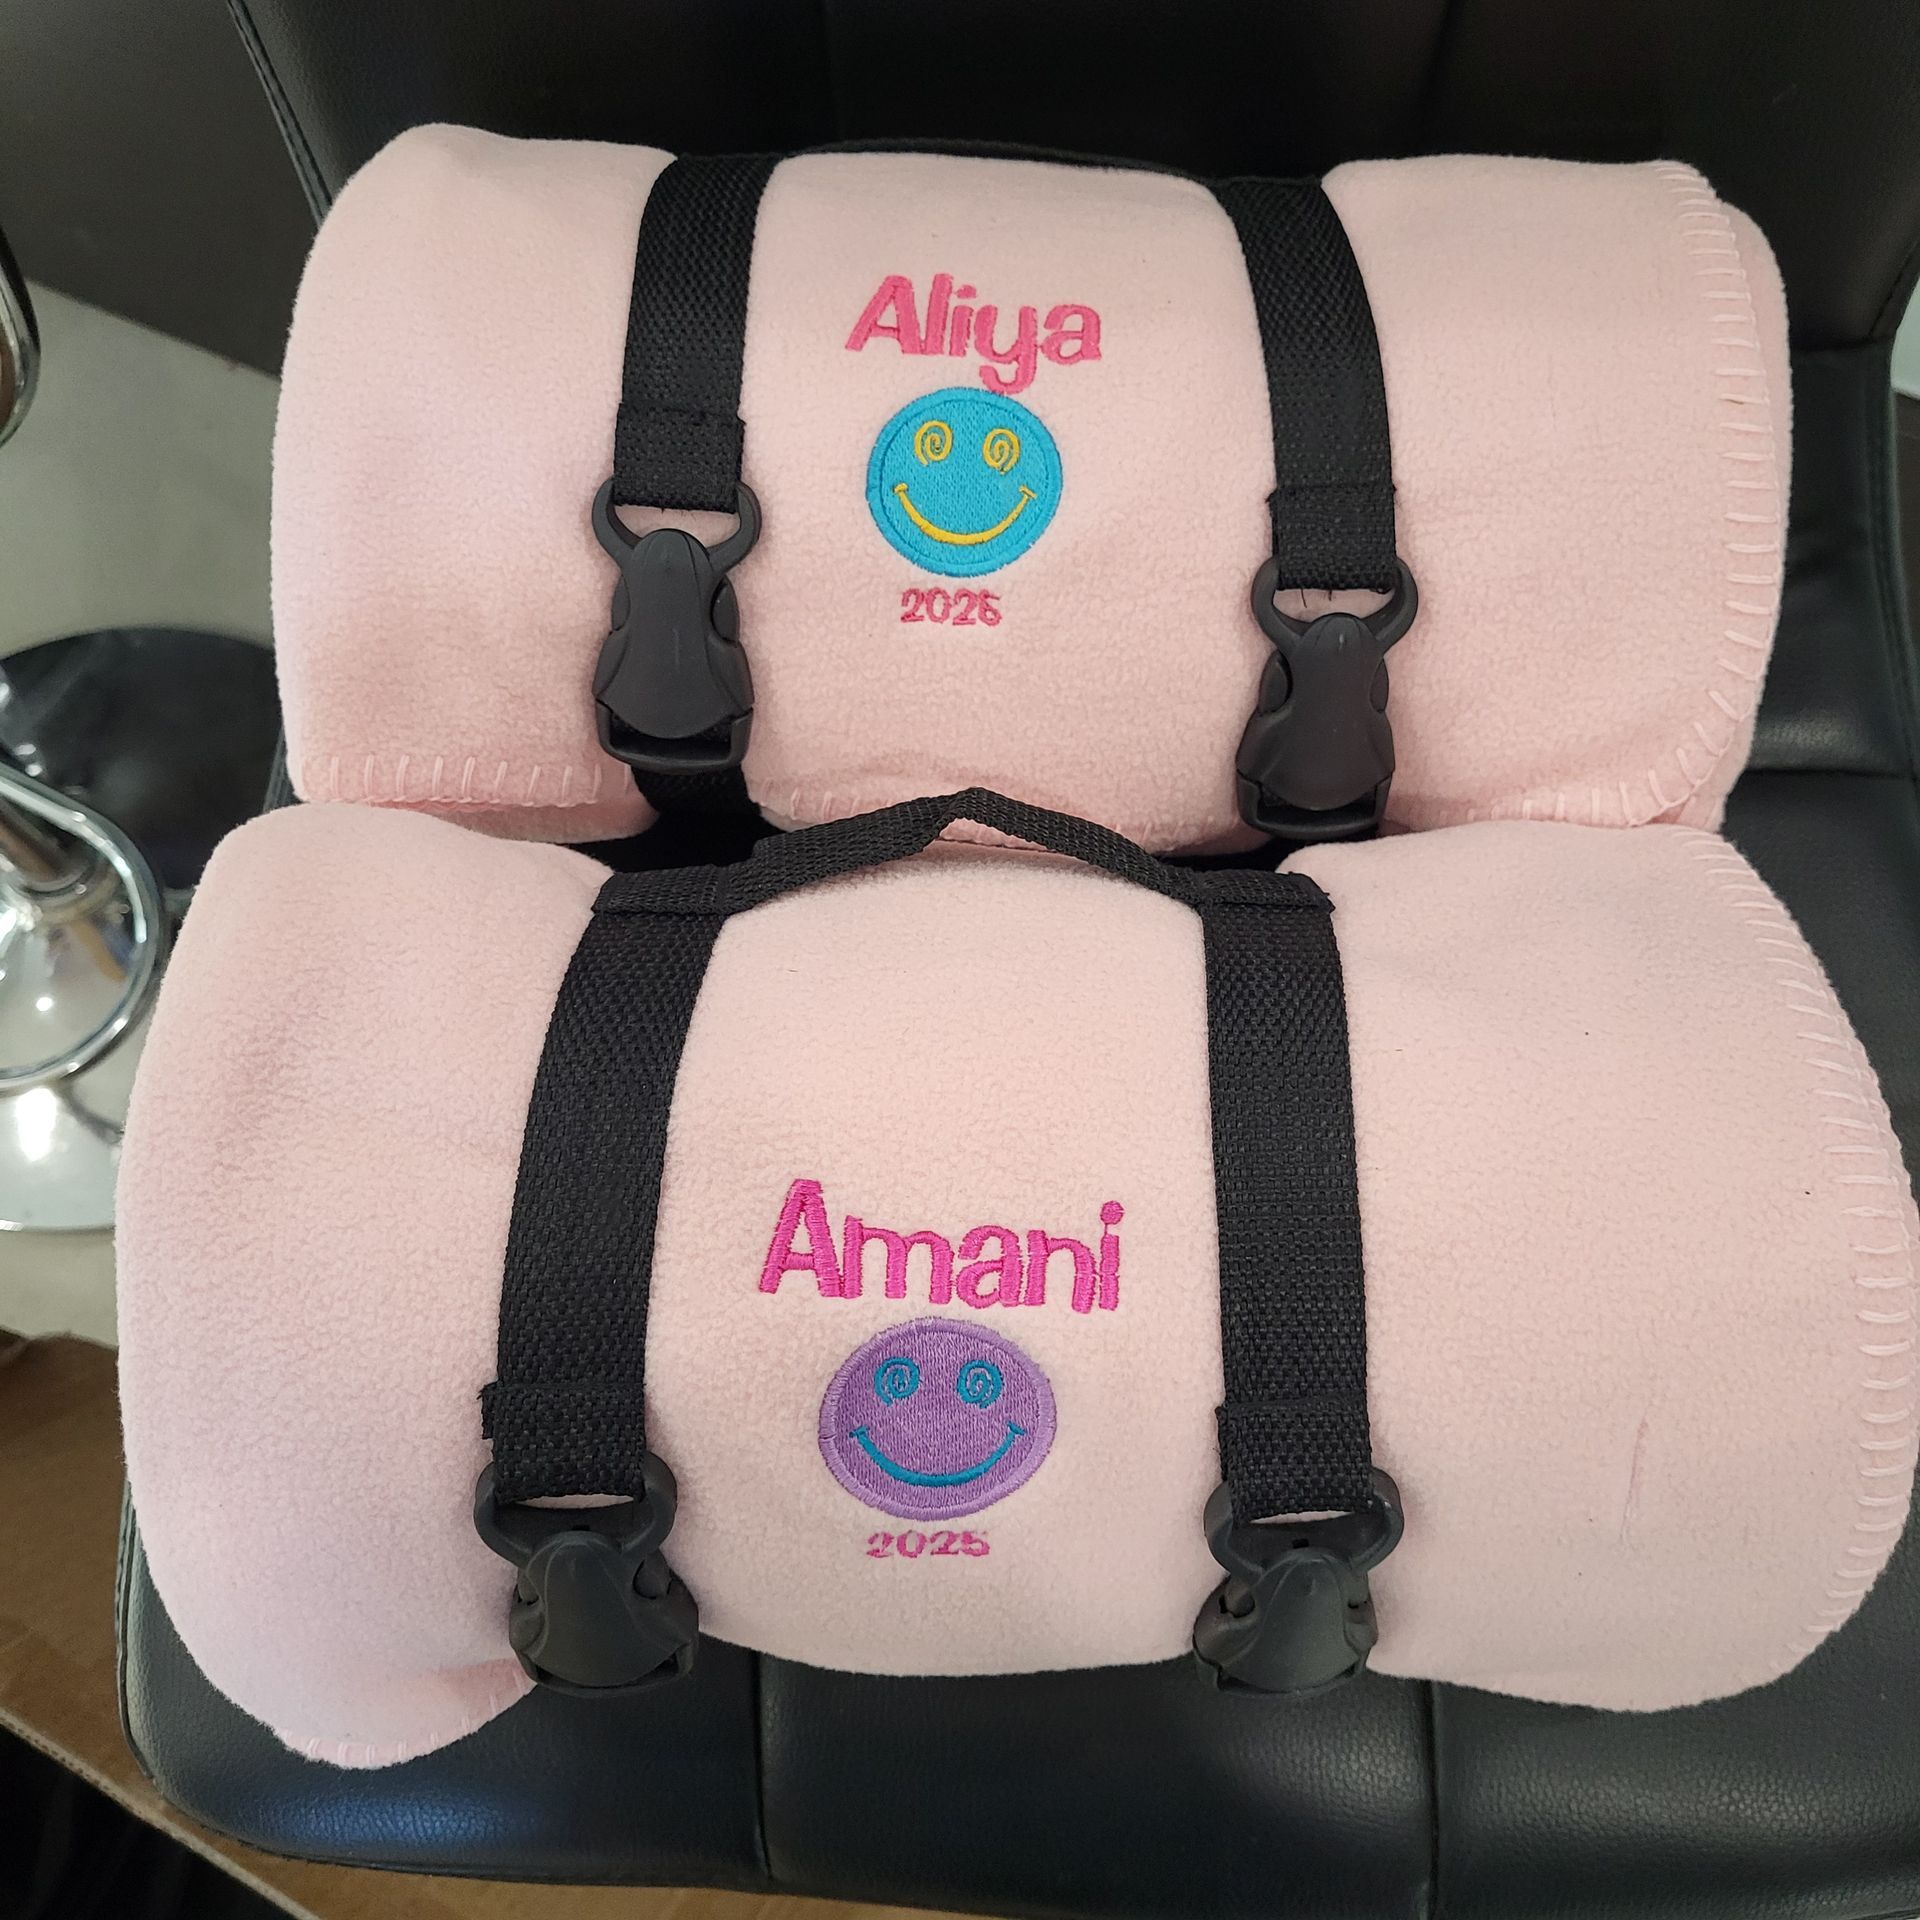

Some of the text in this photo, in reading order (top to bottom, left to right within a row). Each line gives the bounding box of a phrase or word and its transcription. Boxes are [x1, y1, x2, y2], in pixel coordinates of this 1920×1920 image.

[845, 273, 1102, 395] Aliya
[759, 1179, 1125, 1314] Amani
[867, 1530, 990, 1558] 2025
